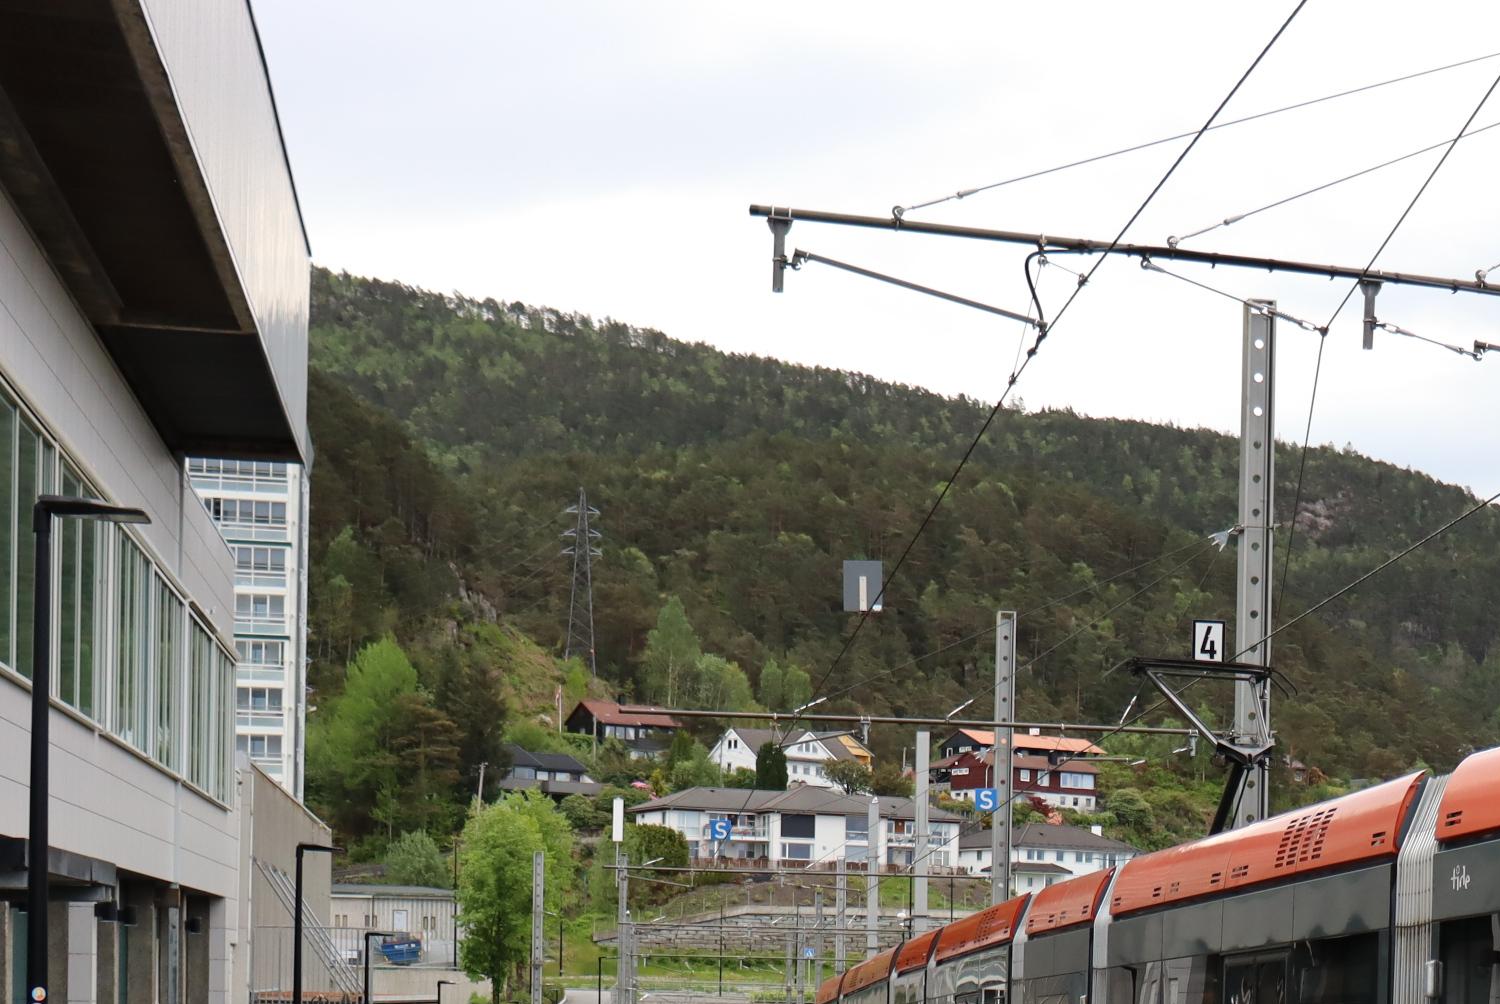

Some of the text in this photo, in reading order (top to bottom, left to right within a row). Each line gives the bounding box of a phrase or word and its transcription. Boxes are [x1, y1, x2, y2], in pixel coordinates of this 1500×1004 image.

[1200, 625, 1217, 659] 4
[979, 790, 993, 810] S
[715, 821, 728, 839] S
